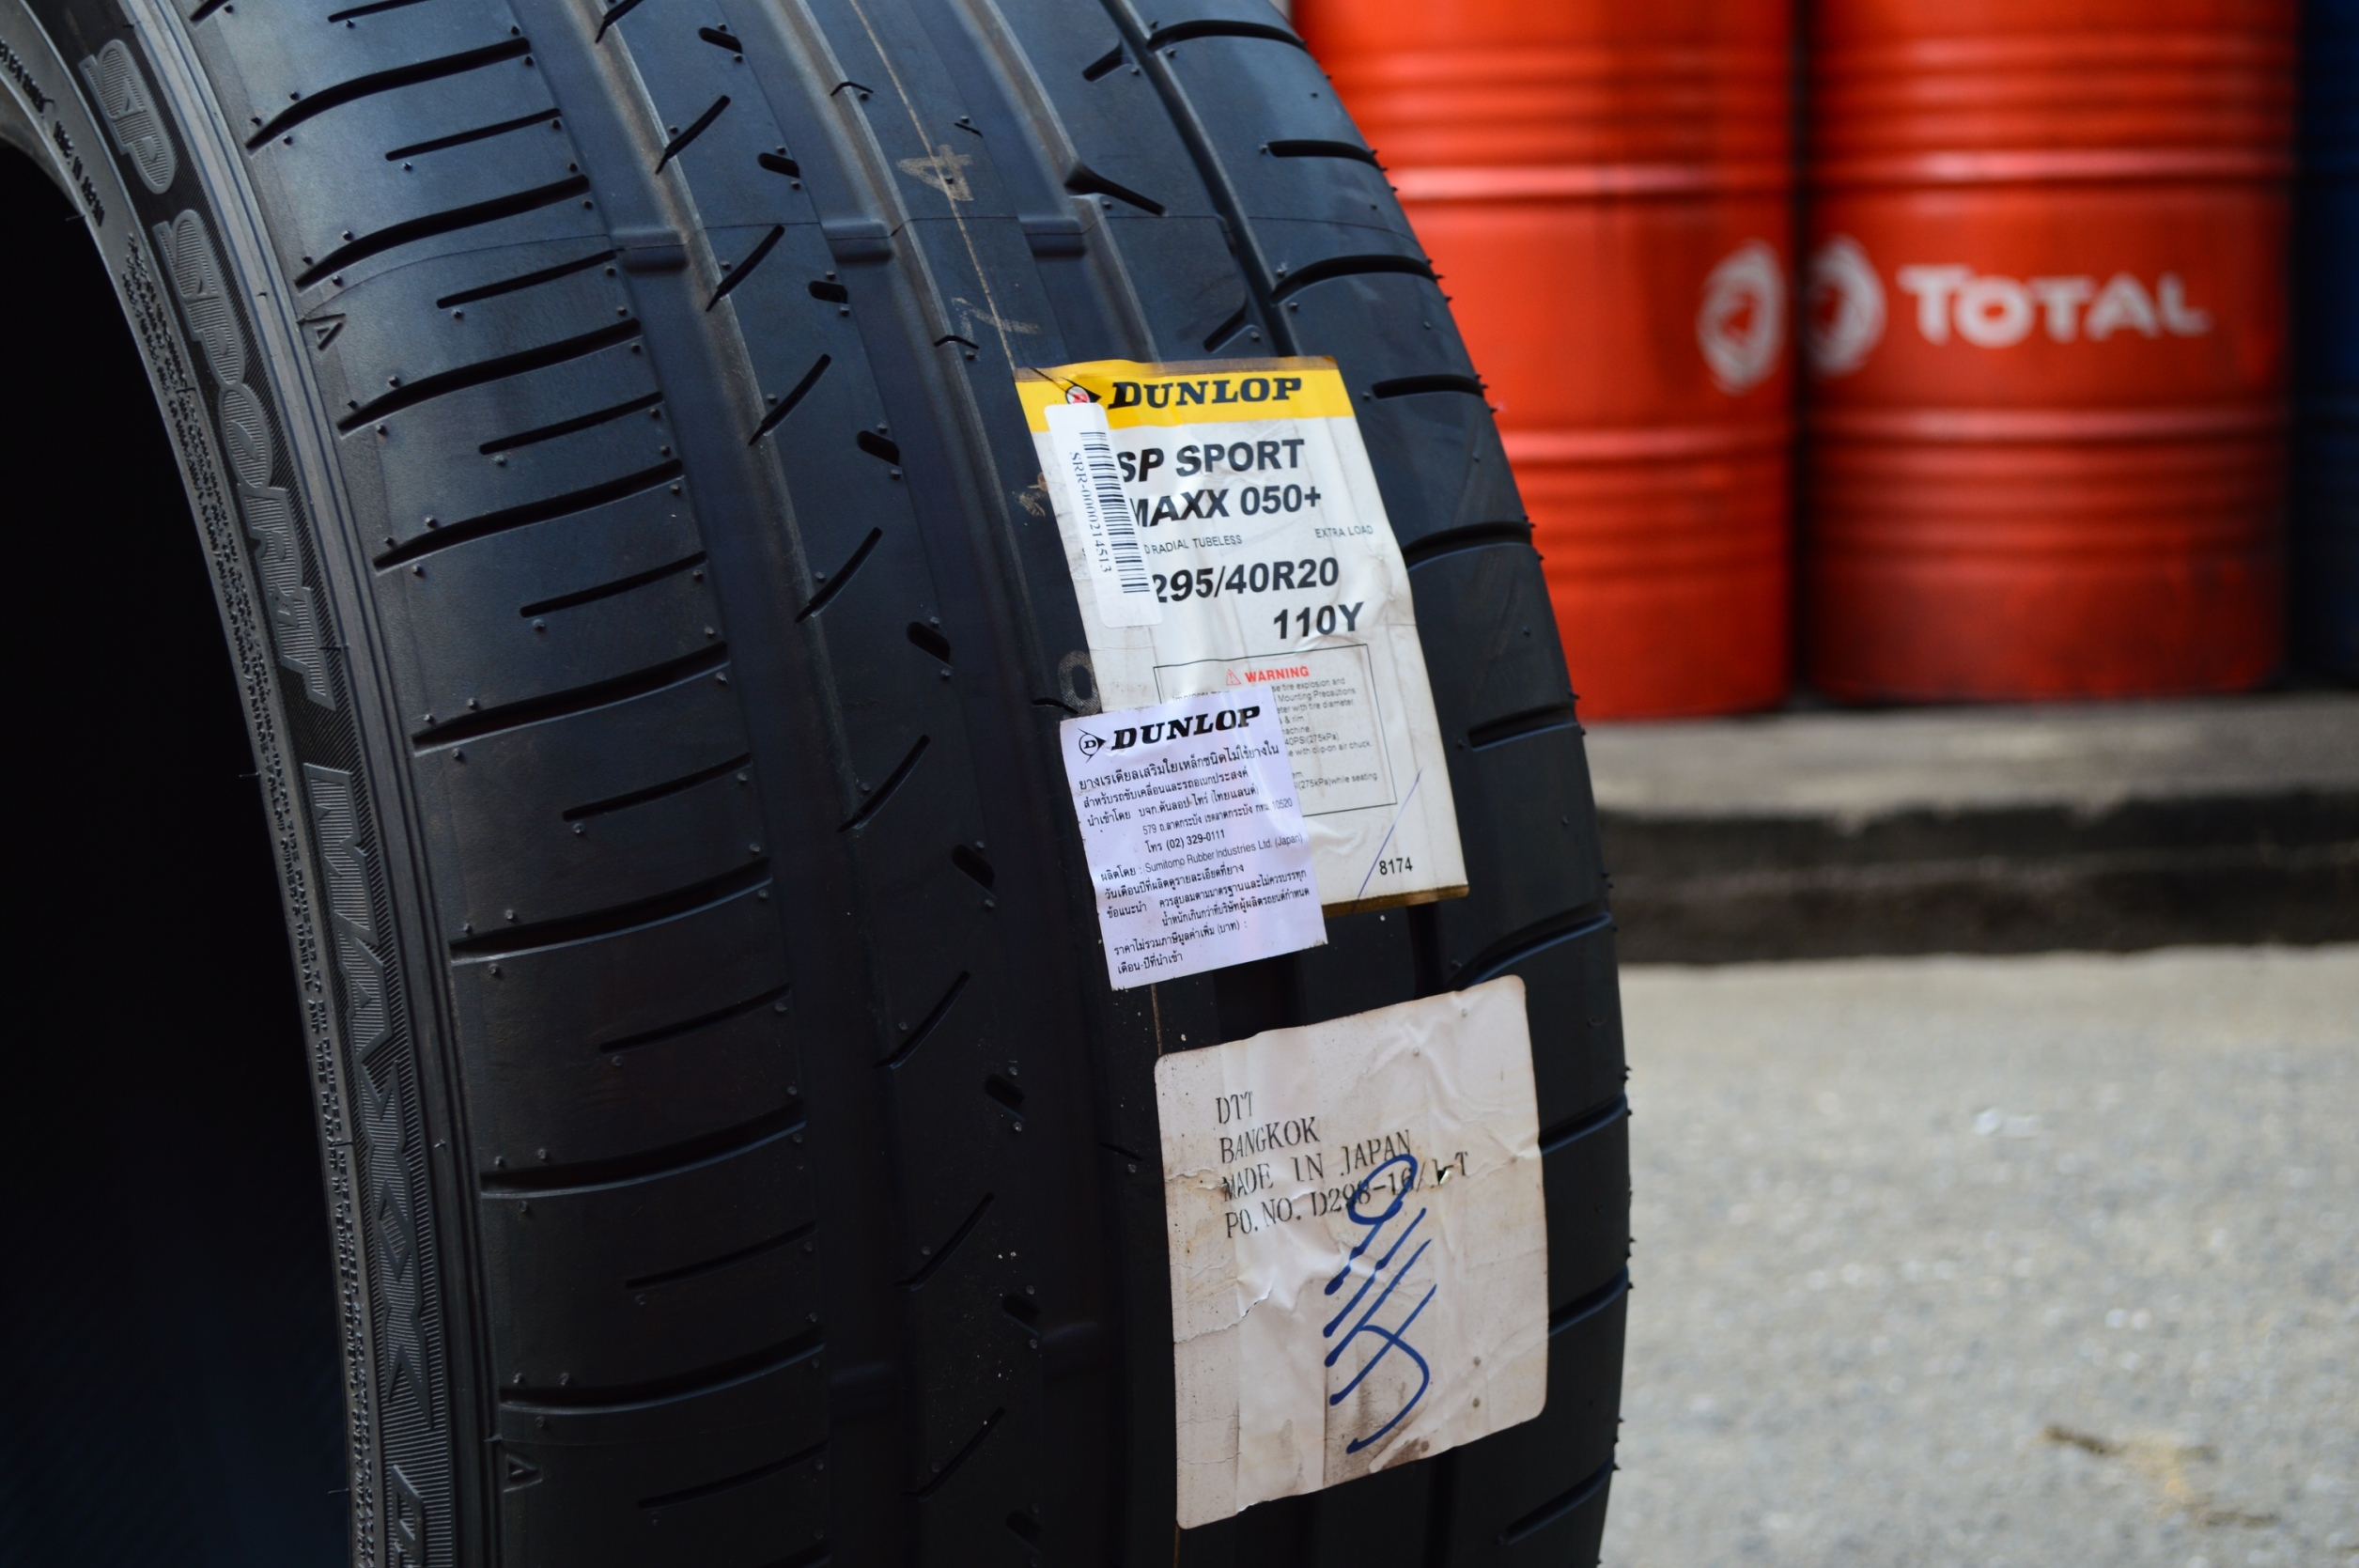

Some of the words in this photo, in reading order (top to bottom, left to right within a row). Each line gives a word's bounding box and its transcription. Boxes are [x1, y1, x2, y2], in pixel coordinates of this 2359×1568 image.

[1108, 378, 1302, 410] DUNLOP
[1116, 447, 1164, 483] SP
[1175, 439, 1305, 477] SPORT
[1240, 483, 1322, 517] 050+
[1151, 539, 1189, 554] RADIAL
[1191, 535, 1243, 549] TUBELESS
[1315, 527, 1345, 539] EXTRA
[1347, 524, 1373, 536] LOAD
[1152, 557, 1340, 603] 295/40R20
[1273, 601, 1365, 640] 110Y
[1244, 666, 1310, 683] WARNING
[1278, 692, 1312, 703] Mounting
[79, 39, 177, 194] SP
[152, 209, 336, 710] SPORT
[303, 762, 433, 1430] MAXX
[1110, 706, 1261, 751] DUNLOP
[1142, 823, 1157, 835] 579
[1166, 837, 1185, 852] (02)
[1187, 829, 1226, 846] 329-0111
[1144, 858, 1186, 874] Sumitomo
[1187, 851, 1215, 865] Rubber
[1216, 844, 1257, 859] Industries
[1275, 832, 1303, 849] (Japan)
[1378, 856, 1414, 876] 8174
[1219, 1116, 1320, 1164] BANGKOK
[1222, 1163, 1274, 1203] MADE
[1291, 1153, 1325, 1183] IN
[1340, 1129, 1411, 1176] JAPAN
